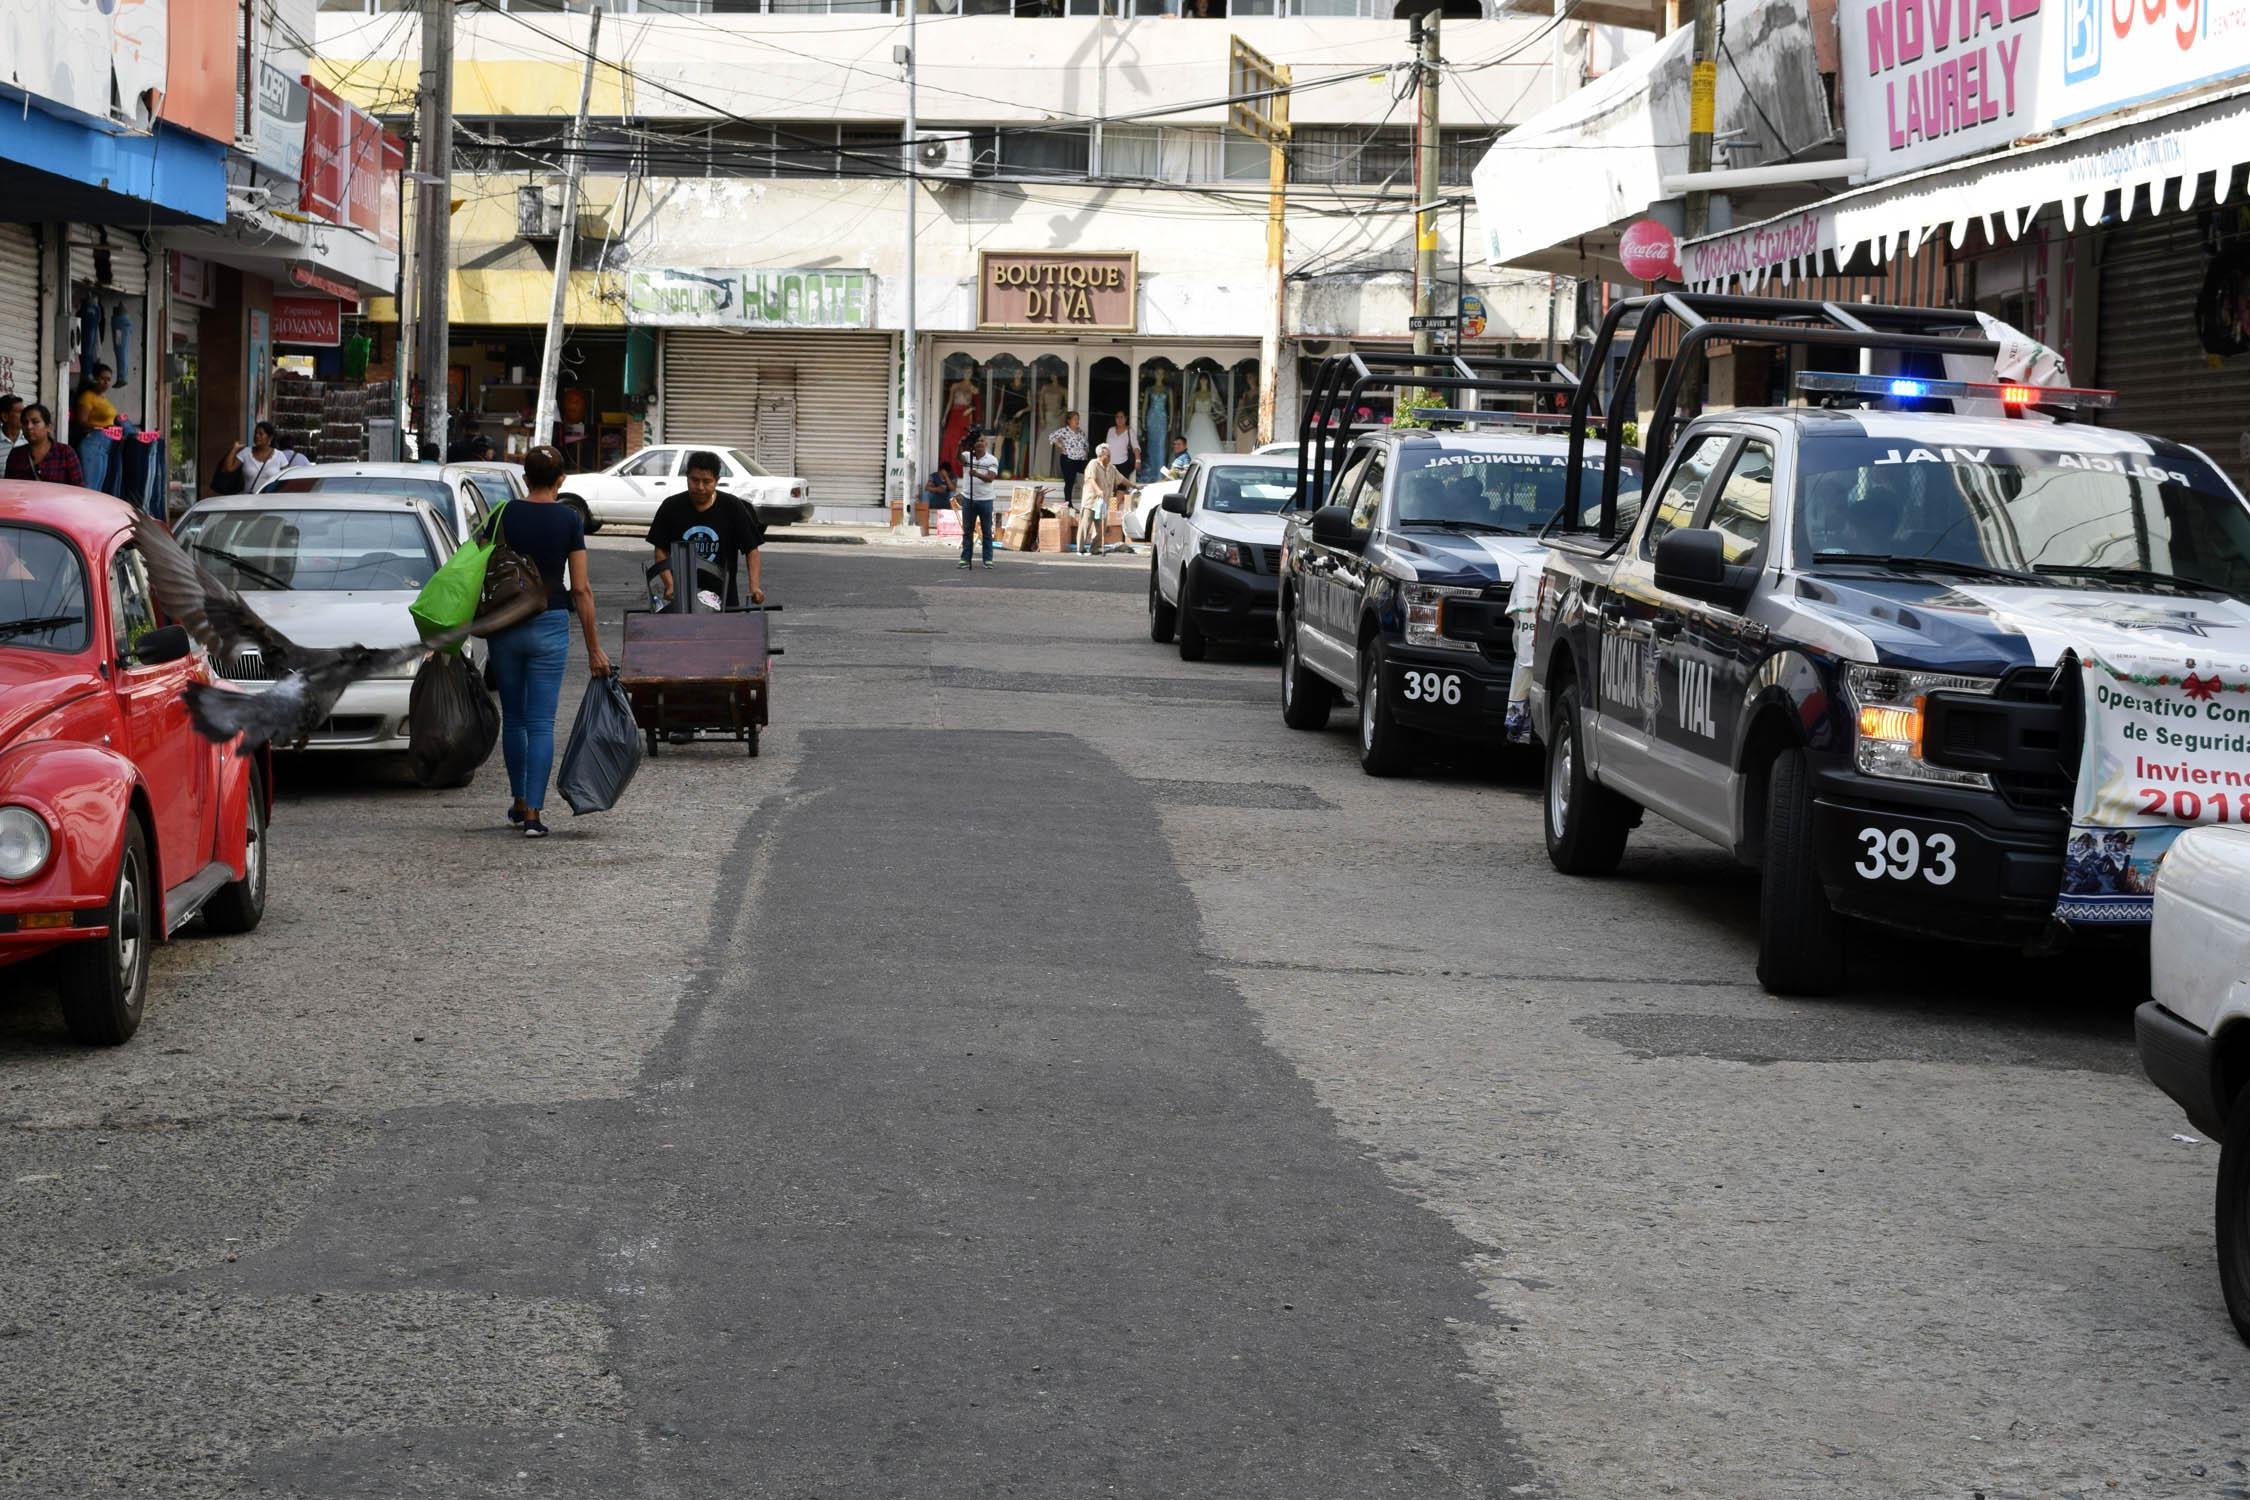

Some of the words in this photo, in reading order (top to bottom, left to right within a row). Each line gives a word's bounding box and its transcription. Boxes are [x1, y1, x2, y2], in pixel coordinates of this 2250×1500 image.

[1886, 33, 2022, 151] LAURELY
[993, 264, 1120, 288] BOUTIQUE
[1025, 287, 1091, 319] DIVA
[1426, 319, 1447, 327] JAVIER
[1403, 671, 1461, 705] 396
[1679, 658, 1715, 739] VIAL
[2098, 685, 2197, 718] Operativo
[2206, 702, 2250, 728] Con
[2123, 721, 2148, 741] de
[1855, 827, 1956, 886] 393
